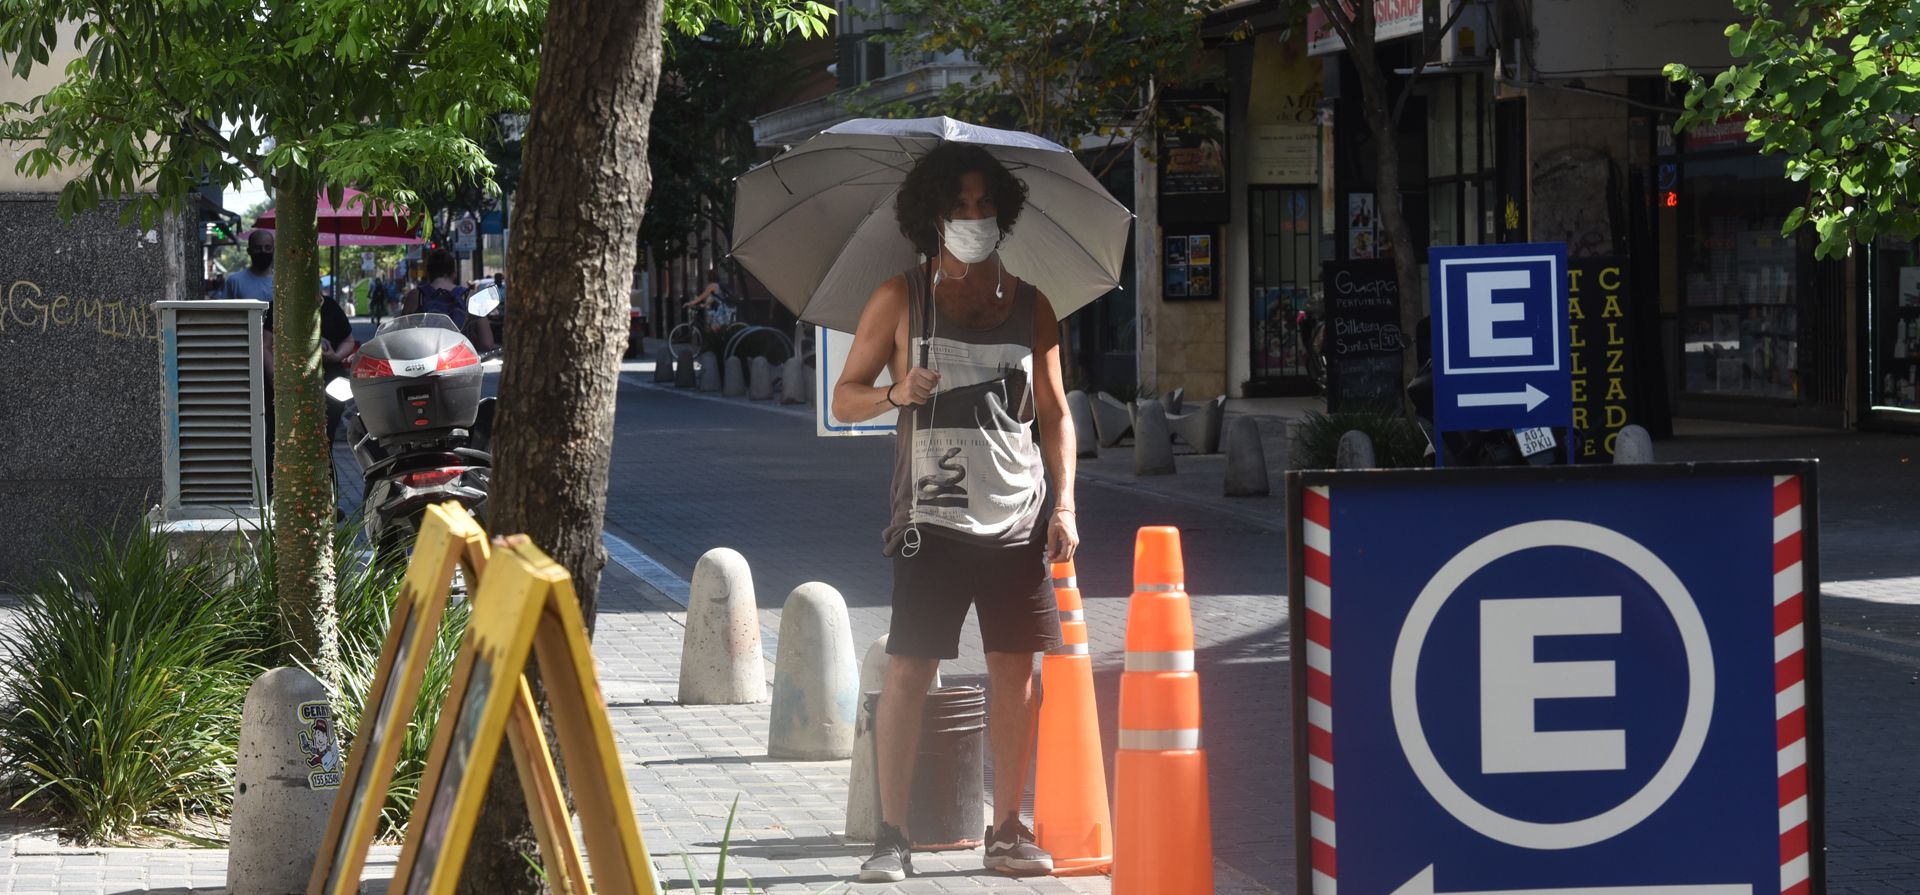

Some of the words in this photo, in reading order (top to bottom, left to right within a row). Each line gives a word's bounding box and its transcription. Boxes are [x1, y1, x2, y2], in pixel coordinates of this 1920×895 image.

[1335, 270, 1398, 296] Guapa
[1466, 269, 1534, 358] E
[1336, 338, 1368, 354] Santa
[1567, 269, 1589, 430] TALLER
[1523, 436, 1552, 454] 3PKU
[1480, 596, 1626, 774] E
